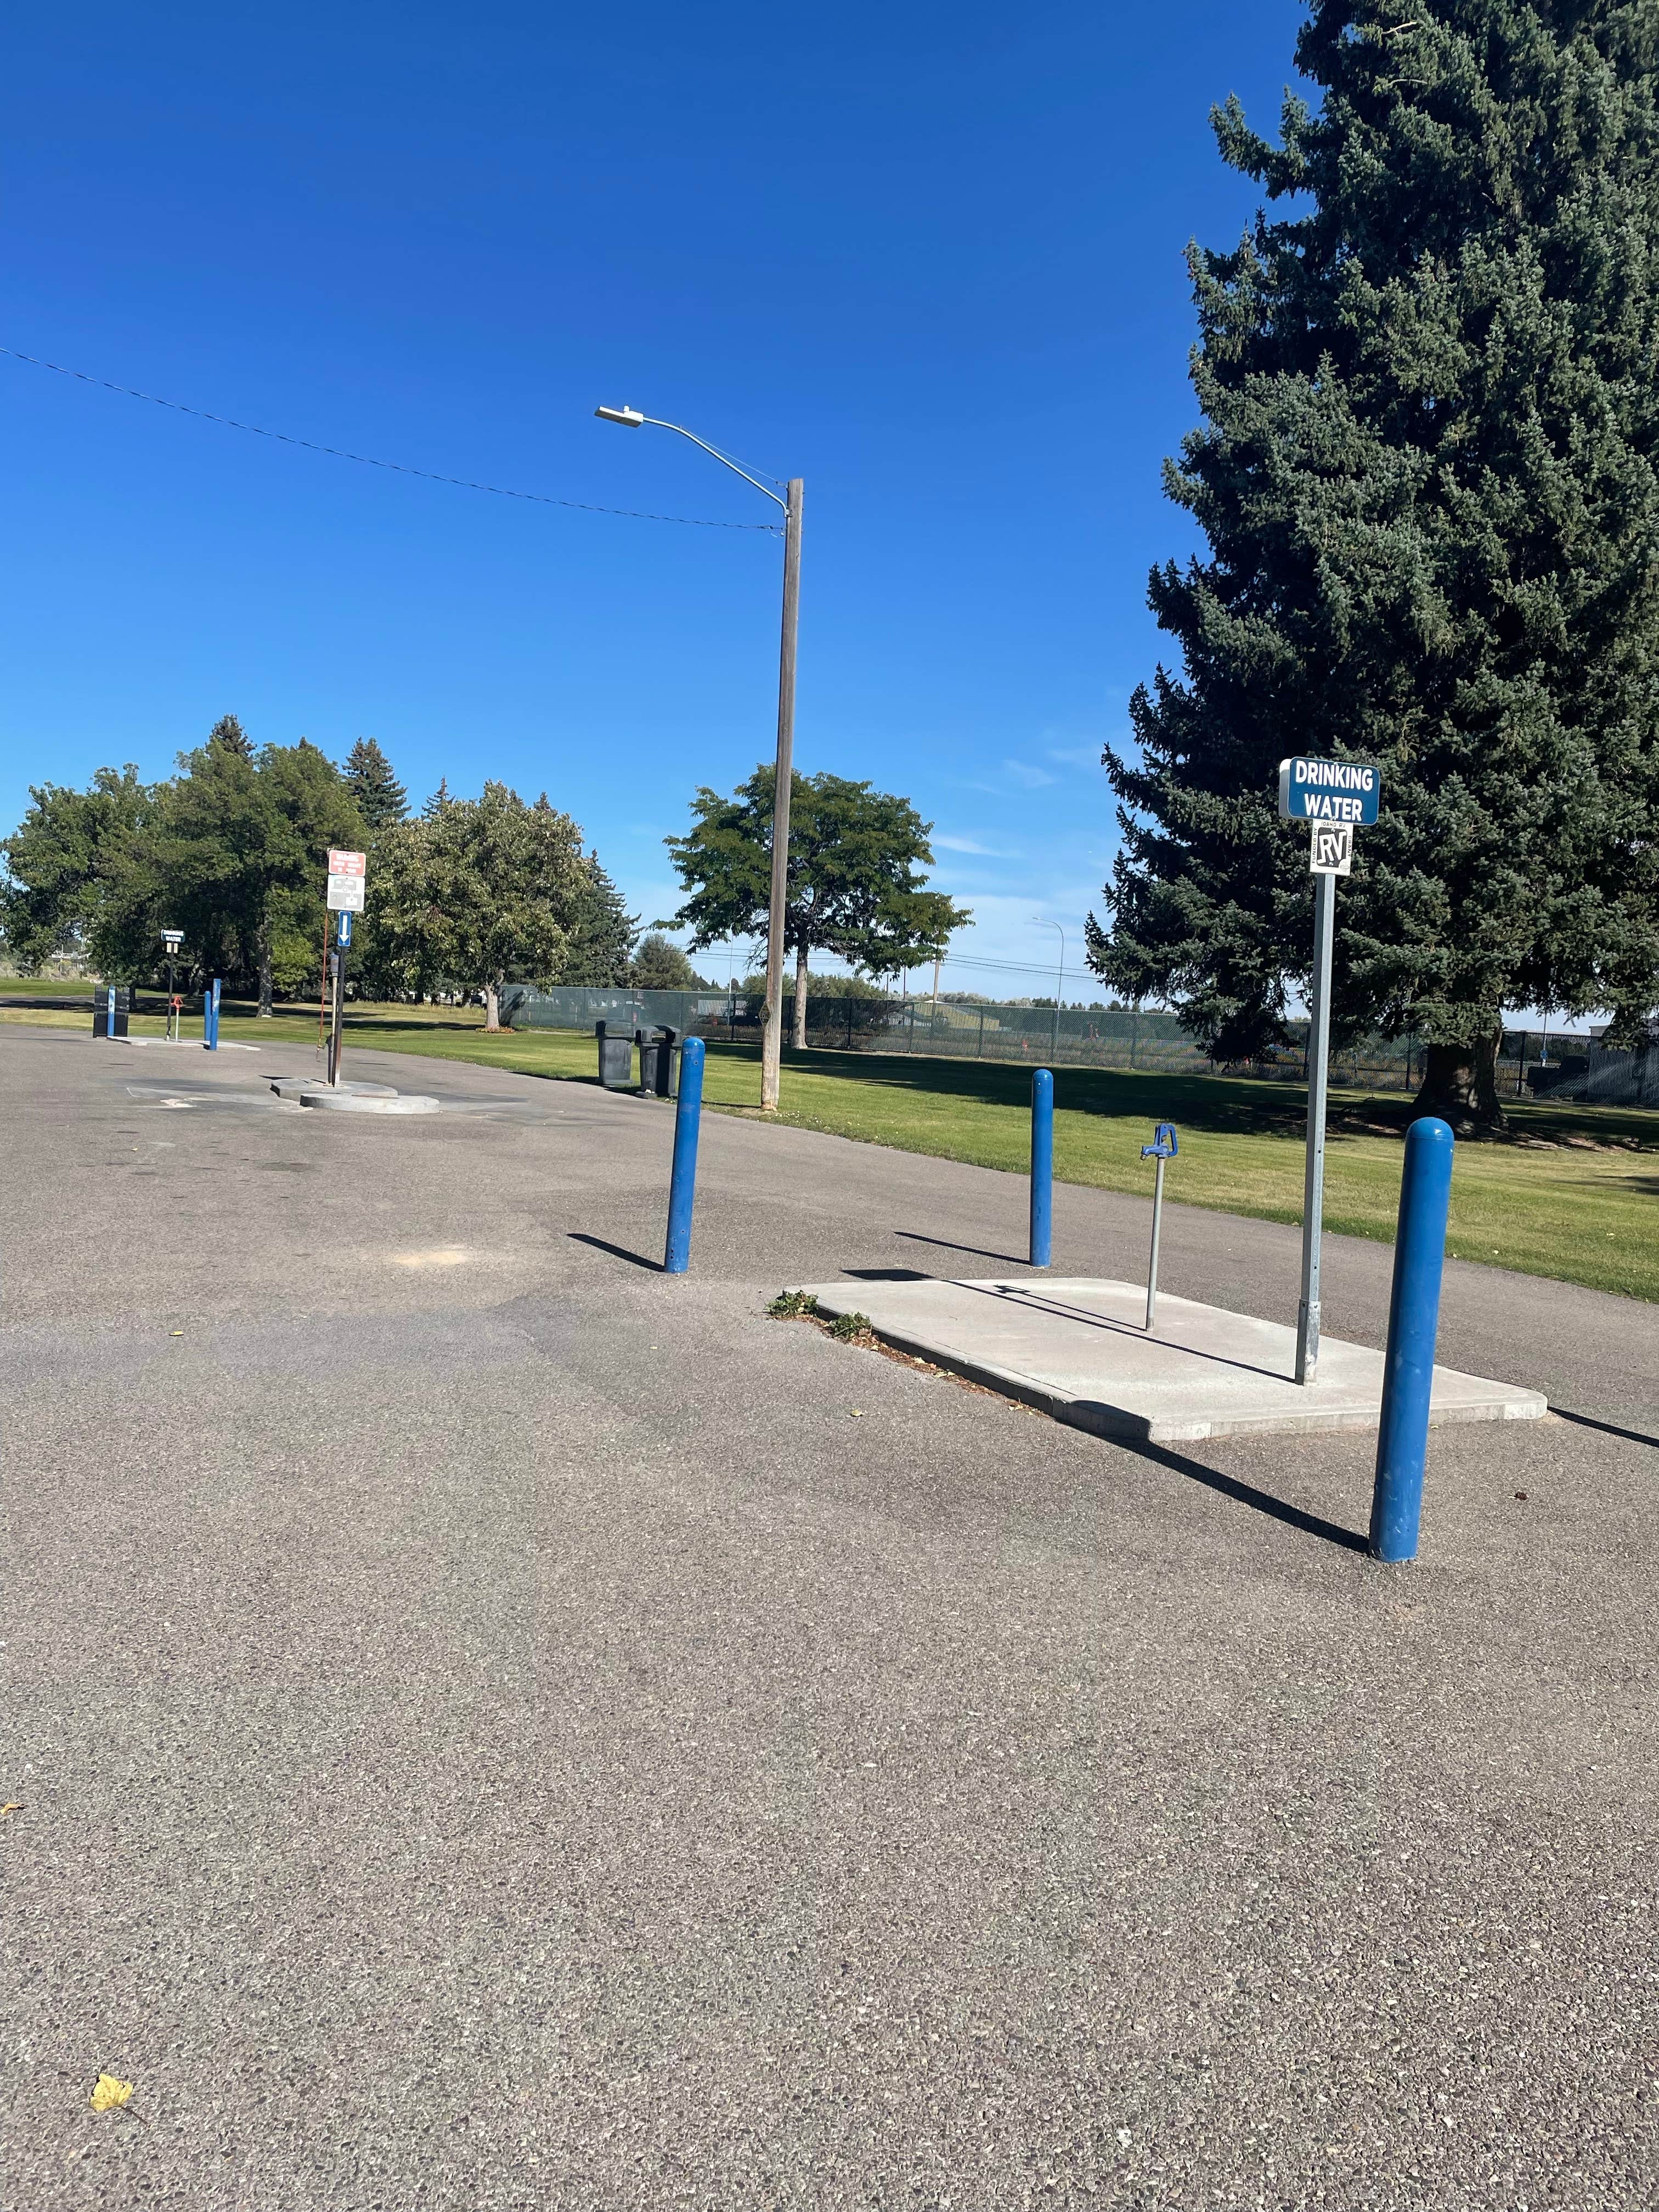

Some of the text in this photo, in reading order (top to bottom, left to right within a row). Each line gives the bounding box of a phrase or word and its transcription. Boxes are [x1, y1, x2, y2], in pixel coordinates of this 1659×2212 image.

[1295, 760, 1373, 791] DRINKING
[1304, 793, 1363, 821] WATER
[1313, 827, 1317, 836] BY
[1317, 831, 1347, 864] RV
